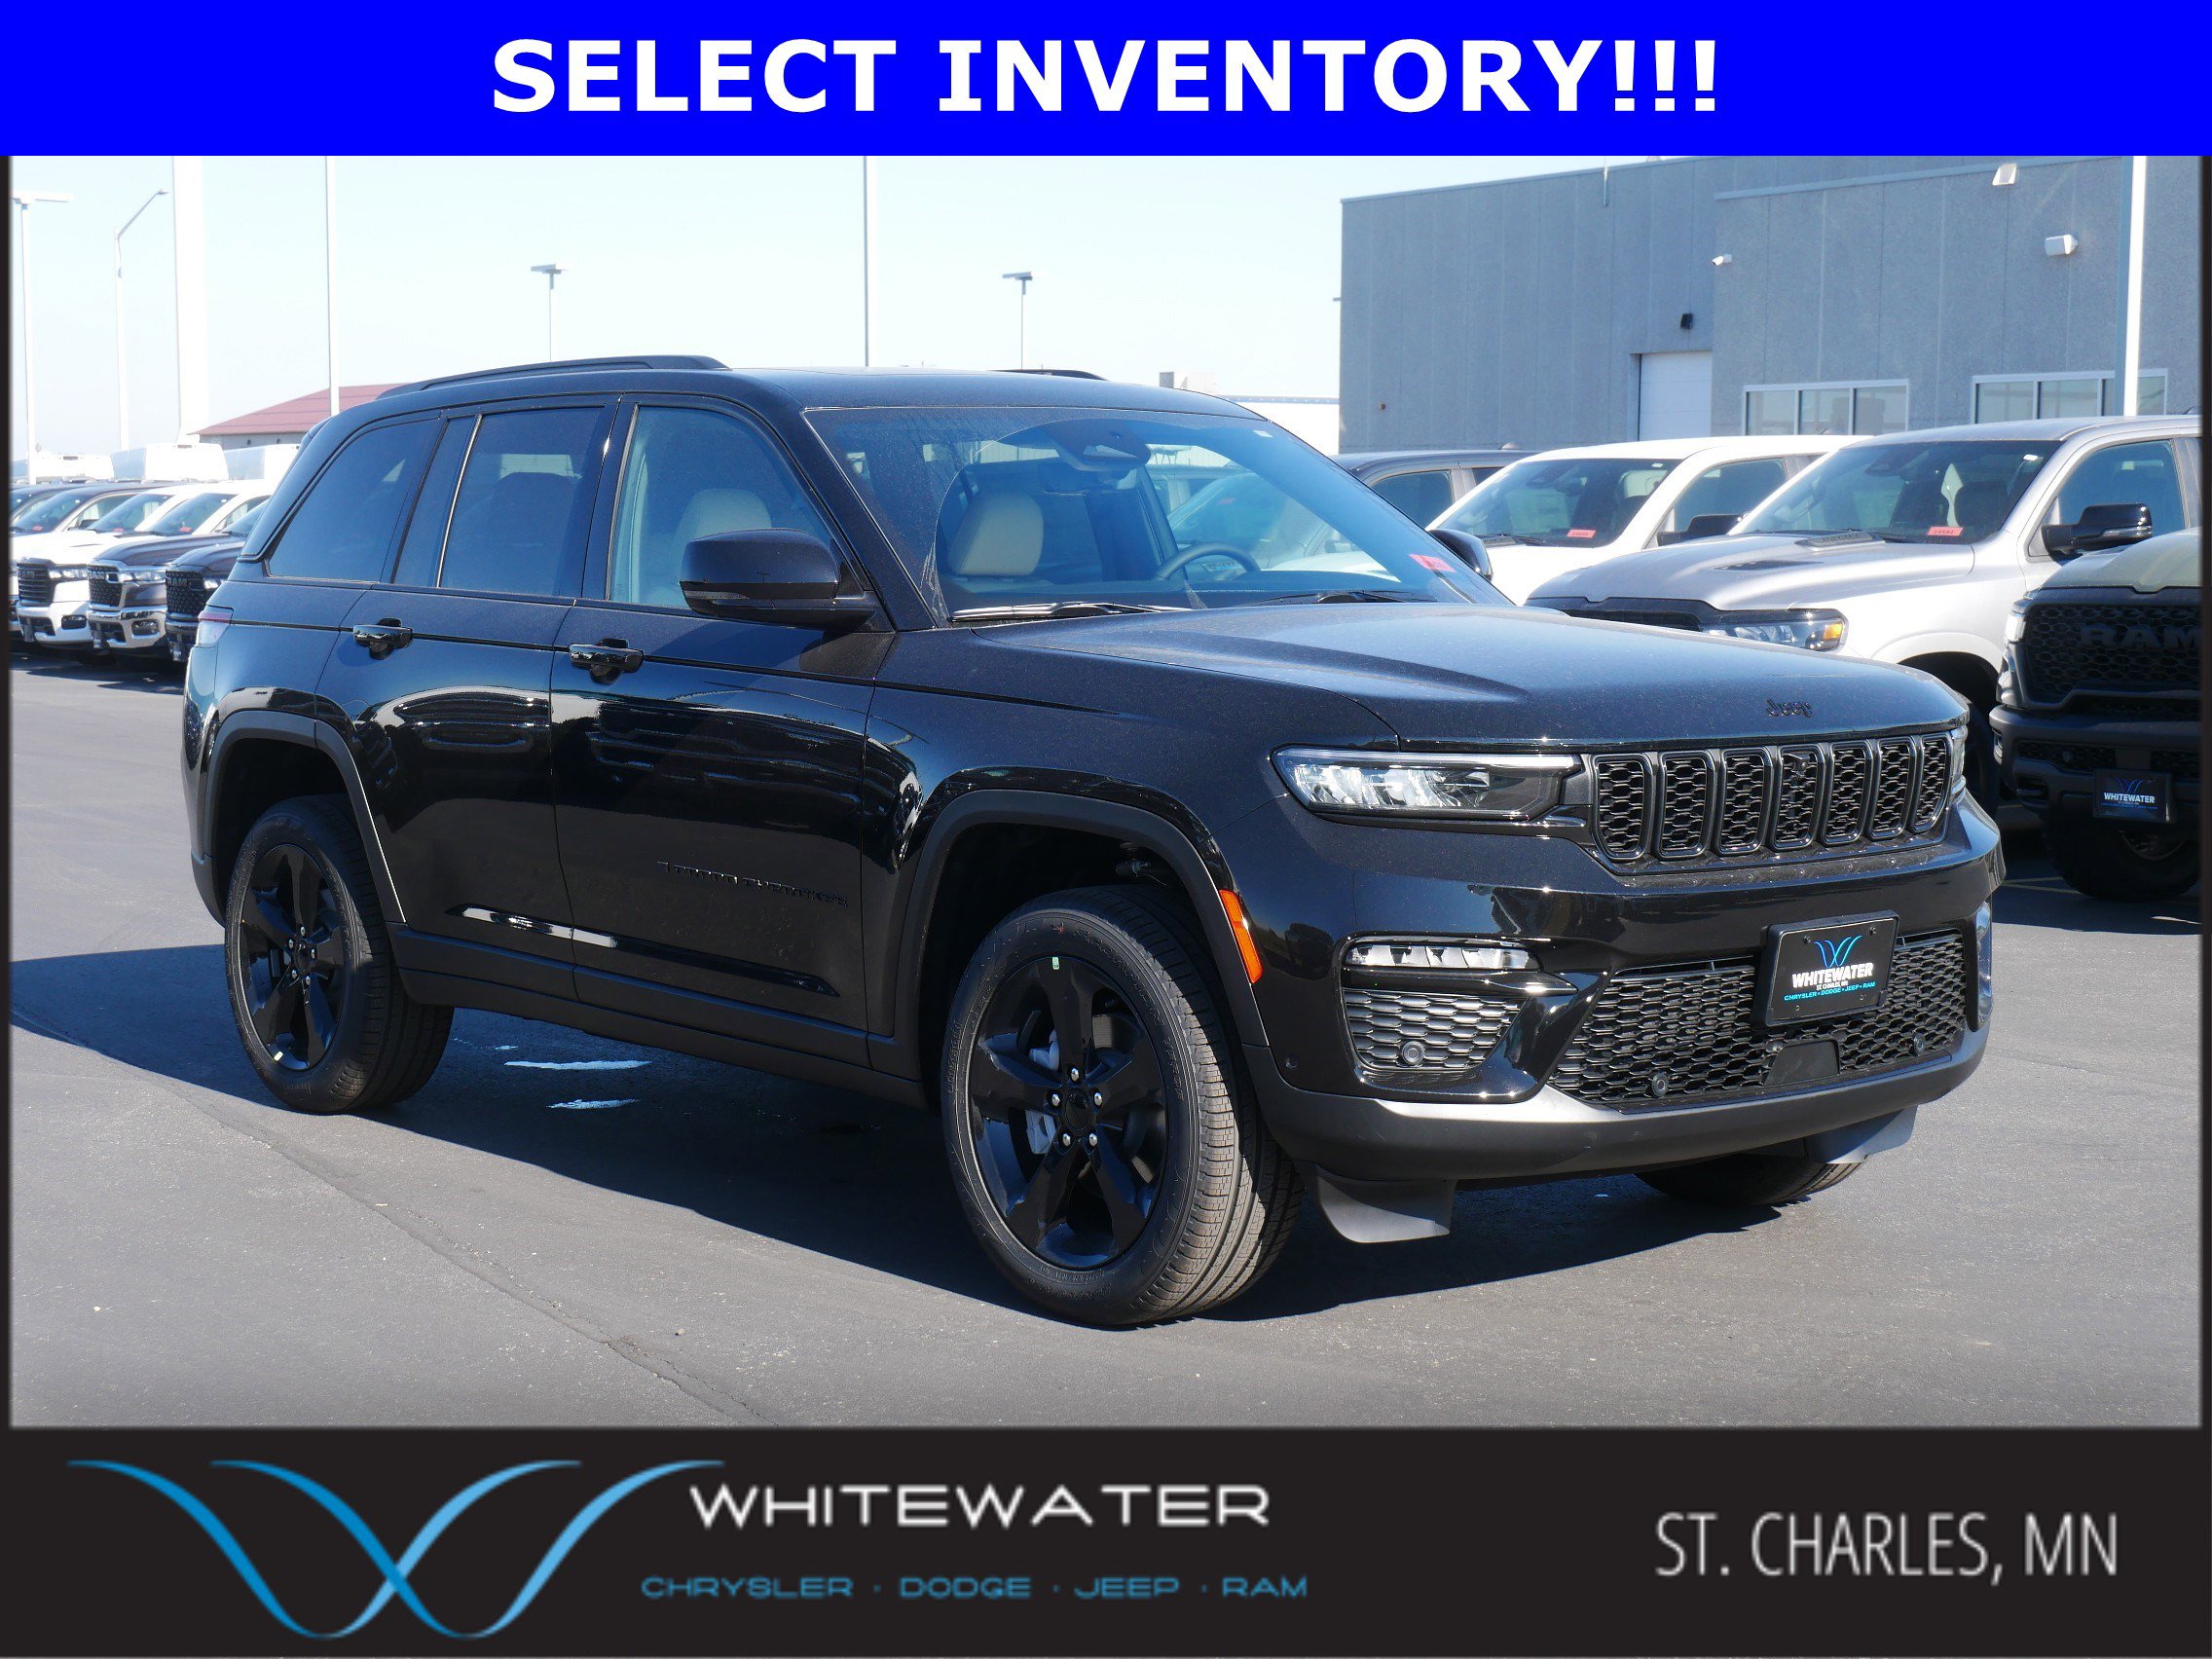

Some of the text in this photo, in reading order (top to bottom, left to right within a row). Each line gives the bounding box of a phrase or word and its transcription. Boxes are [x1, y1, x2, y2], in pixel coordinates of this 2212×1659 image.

[2080, 623, 2201, 649] RAM
[1765, 698, 1813, 719] Jeep
[2104, 792, 2156, 804] WHITEWATER
[1791, 962, 1874, 988] WHITEWATER
[1784, 991, 1818, 1001] CHRYSLER
[1821, 987, 1842, 996] DODGE
[1844, 983, 1860, 992] JEEP
